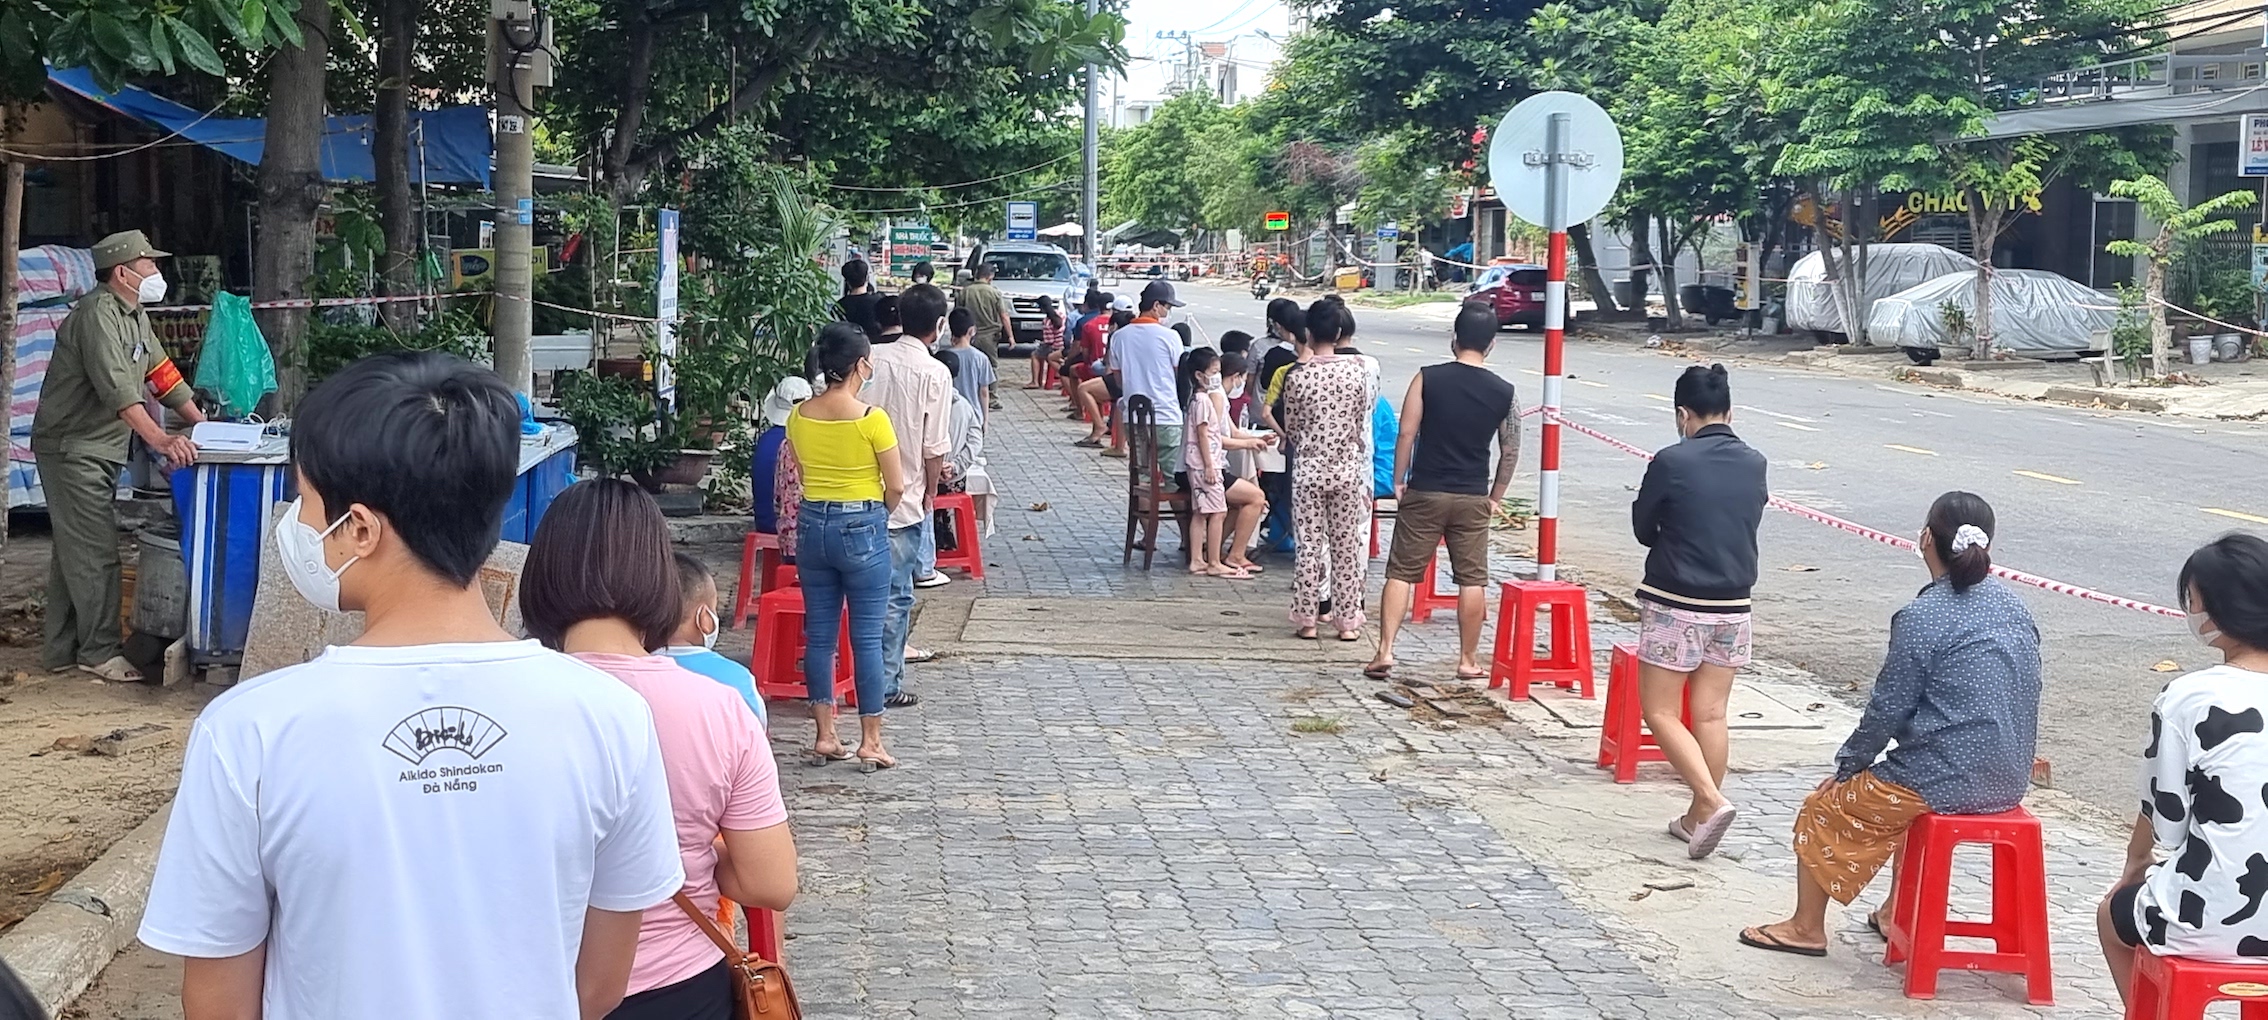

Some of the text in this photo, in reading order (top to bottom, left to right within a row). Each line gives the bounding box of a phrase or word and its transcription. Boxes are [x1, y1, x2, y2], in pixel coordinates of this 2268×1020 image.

[398, 763, 503, 782] Aikido Shindokan
[423, 778, 477, 794] Đà Nẵng
